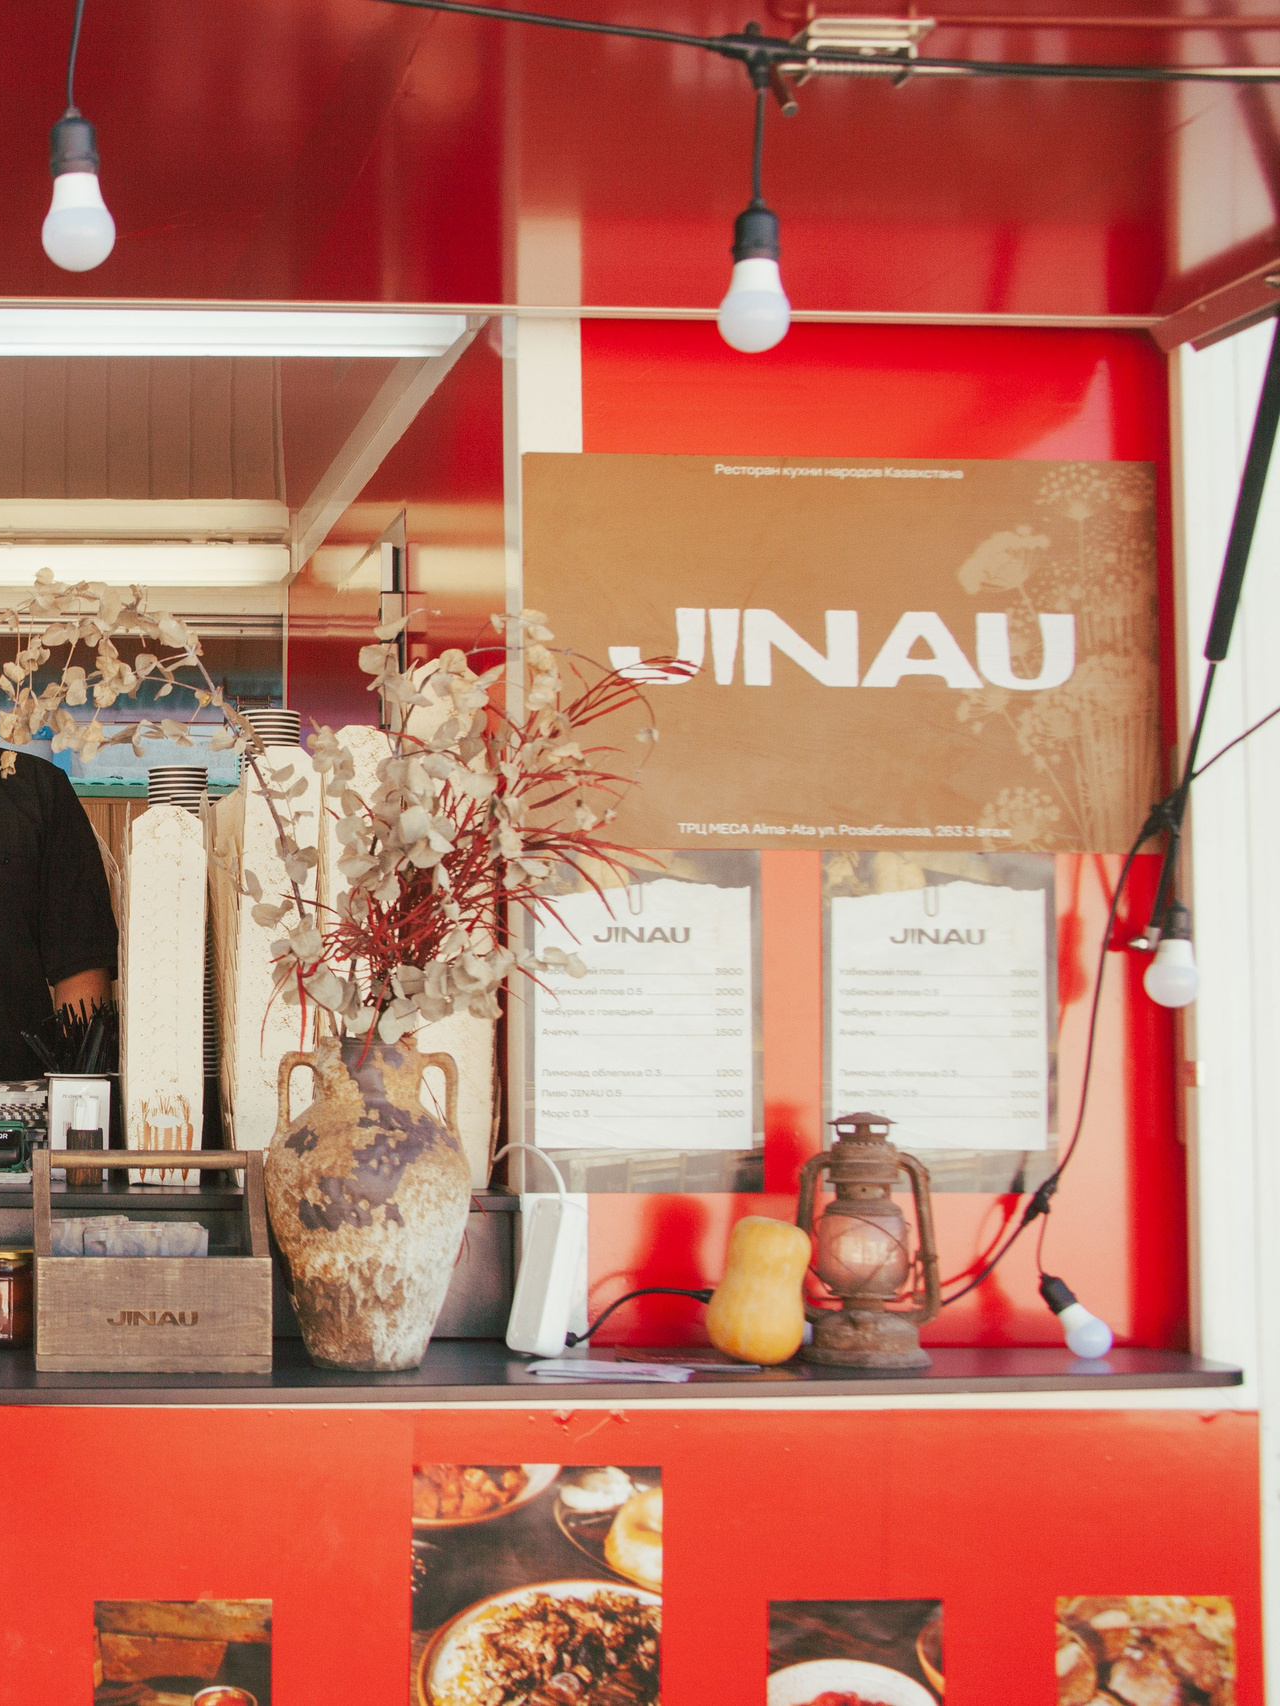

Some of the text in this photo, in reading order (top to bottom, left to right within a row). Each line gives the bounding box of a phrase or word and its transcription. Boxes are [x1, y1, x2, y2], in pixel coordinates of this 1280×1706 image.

[714, 463, 964, 480] Ресторан кухни народов Казахстана
[608, 607, 1076, 691] JINAU
[678, 822, 707, 835] ТРЦ
[752, 823, 816, 836] Alma-Ata
[593, 926, 691, 944] JINAU
[889, 928, 987, 945] JINAU
[714, 987, 745, 996] 2000
[106, 1310, 199, 1327] JINAU
